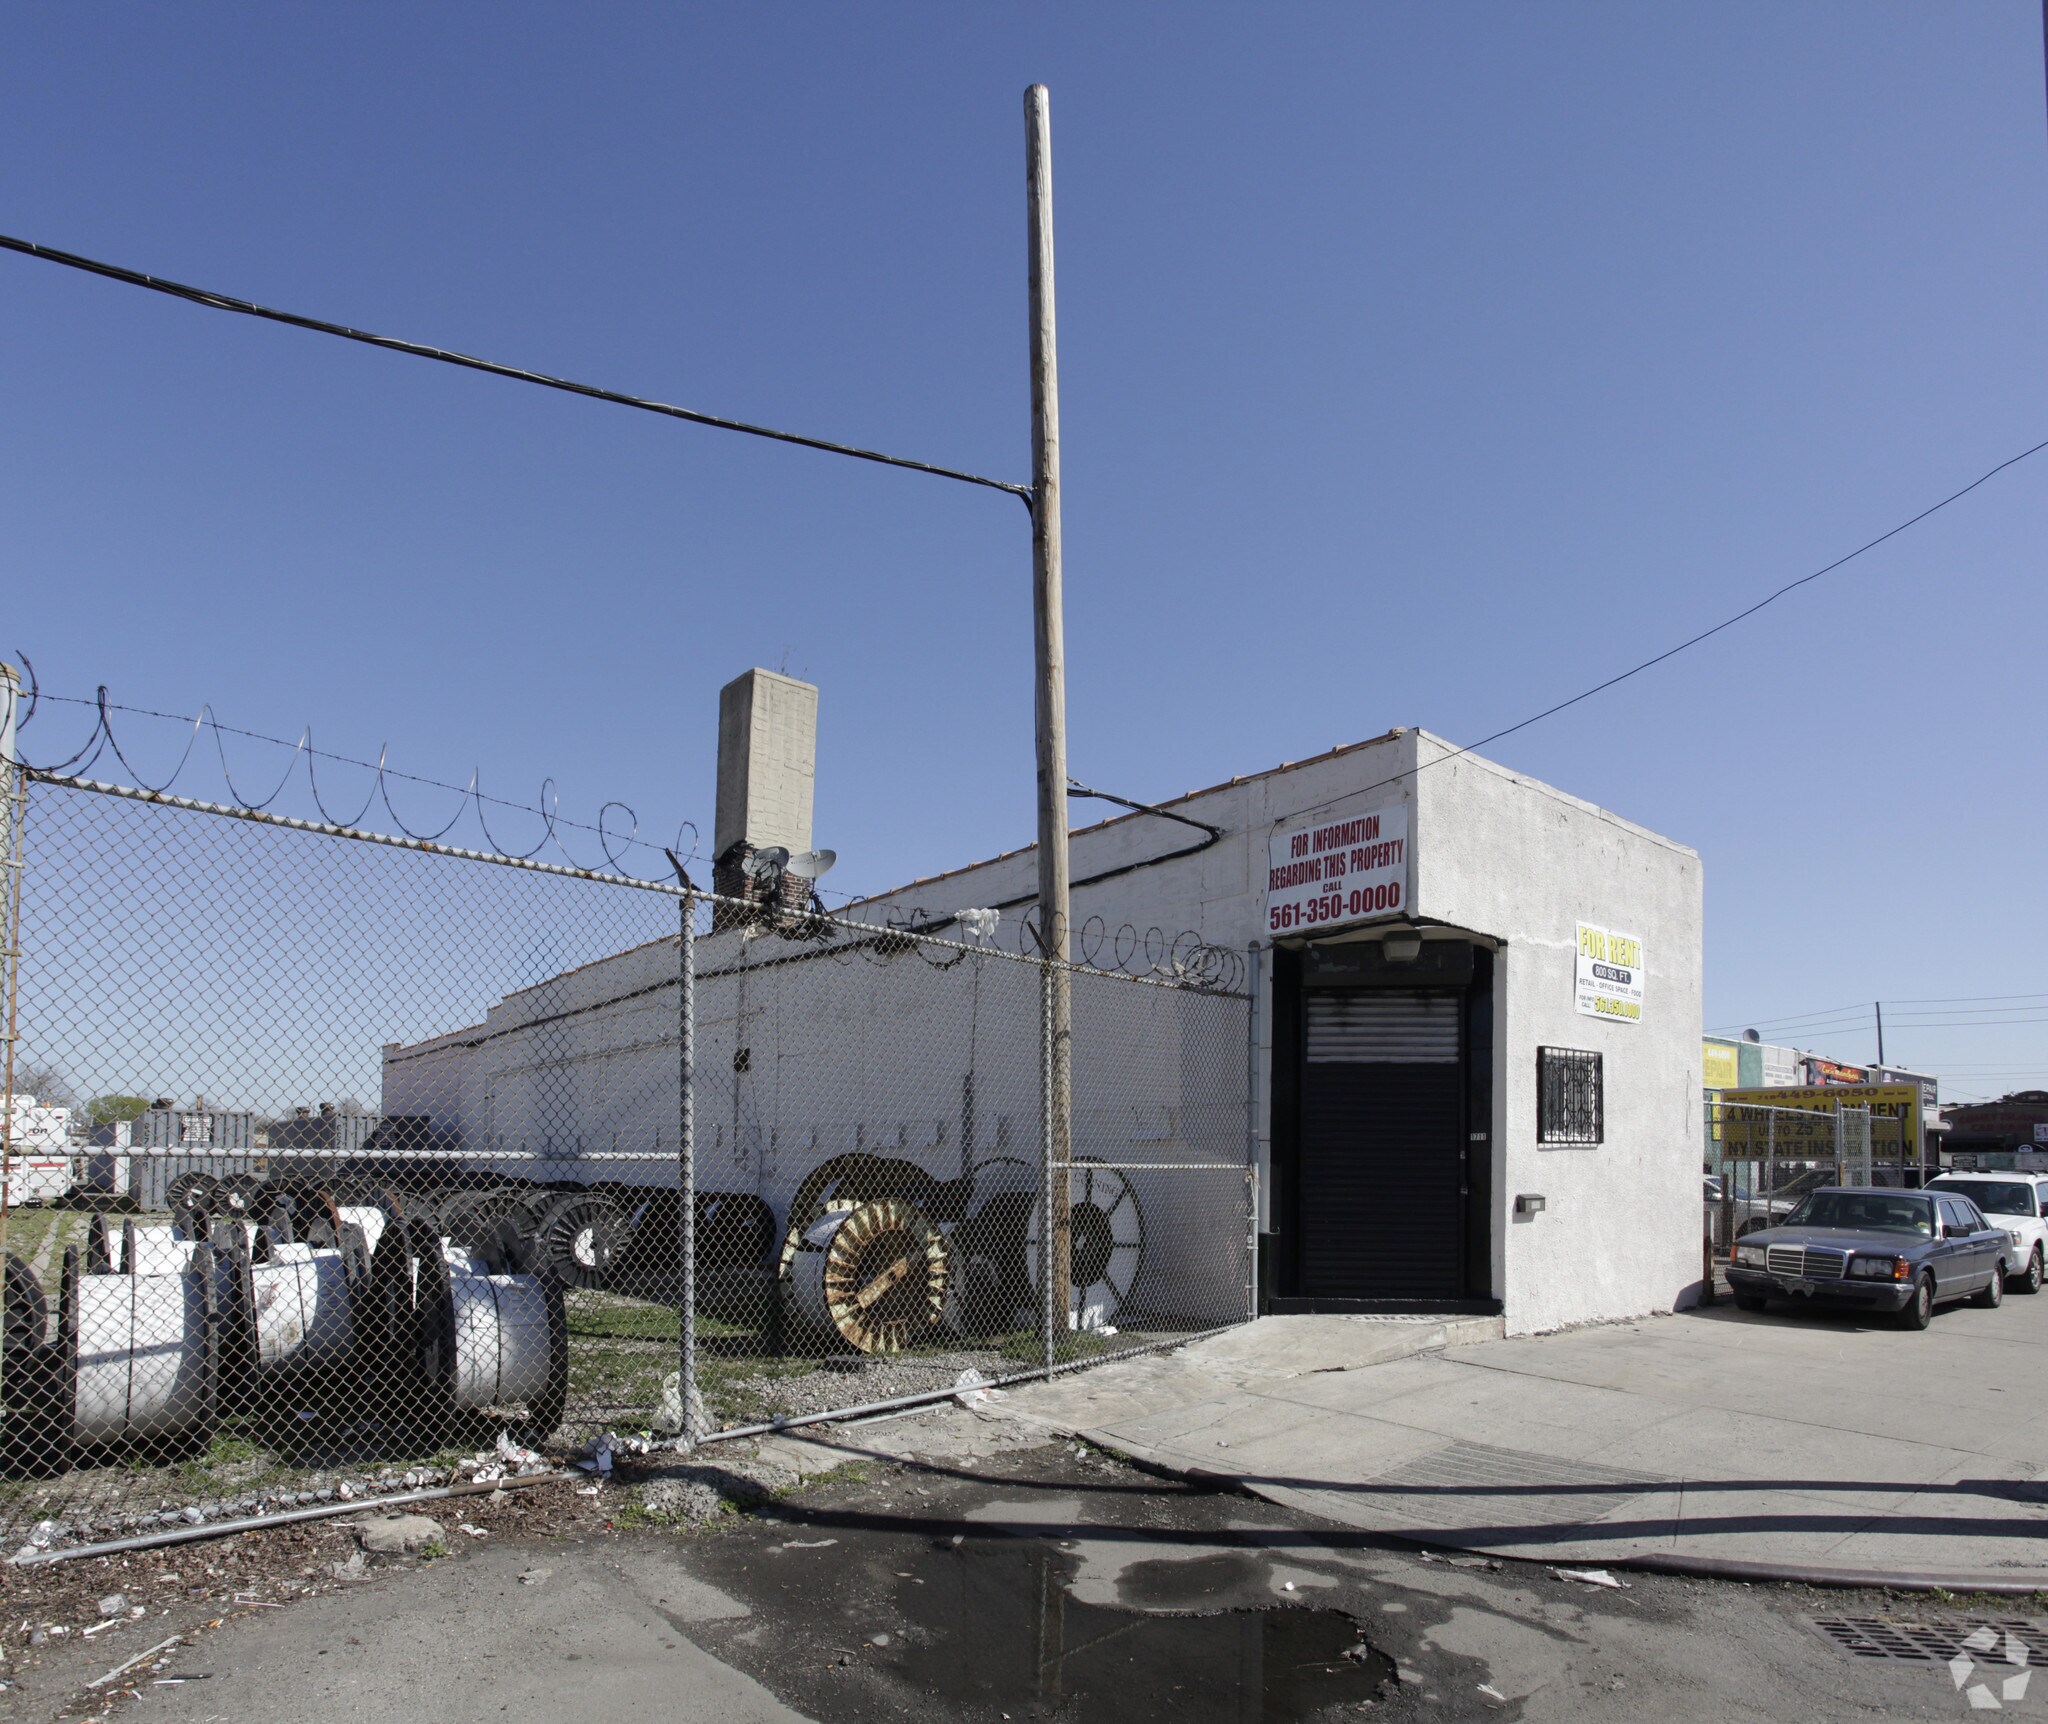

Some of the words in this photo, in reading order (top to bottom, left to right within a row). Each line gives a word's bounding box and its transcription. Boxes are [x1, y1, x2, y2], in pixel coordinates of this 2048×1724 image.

[1290, 833, 1309, 859] FOR
[1312, 815, 1380, 853] INFORMATION
[1269, 857, 1321, 891] REGARDING
[1324, 852, 1346, 879] THIS
[1350, 839, 1404, 873] PROPERTY
[1322, 881, 1342, 894] CALL
[1270, 882, 1400, 930] 561-350-0000
[1578, 926, 1606, 961] FOR
[1607, 934, 1641, 970] RENT
[1595, 966, 1607, 977] 800
[1579, 978, 1595, 988] RETAIL
[1599, 982, 1615, 992] OFFICE
[1615, 986, 1629, 995] SPACE
[1812, 1103, 1911, 1120] ALGNMENT
[1728, 1141, 1748, 1156] NY
[1808, 1140, 1912, 1156] INSETION
